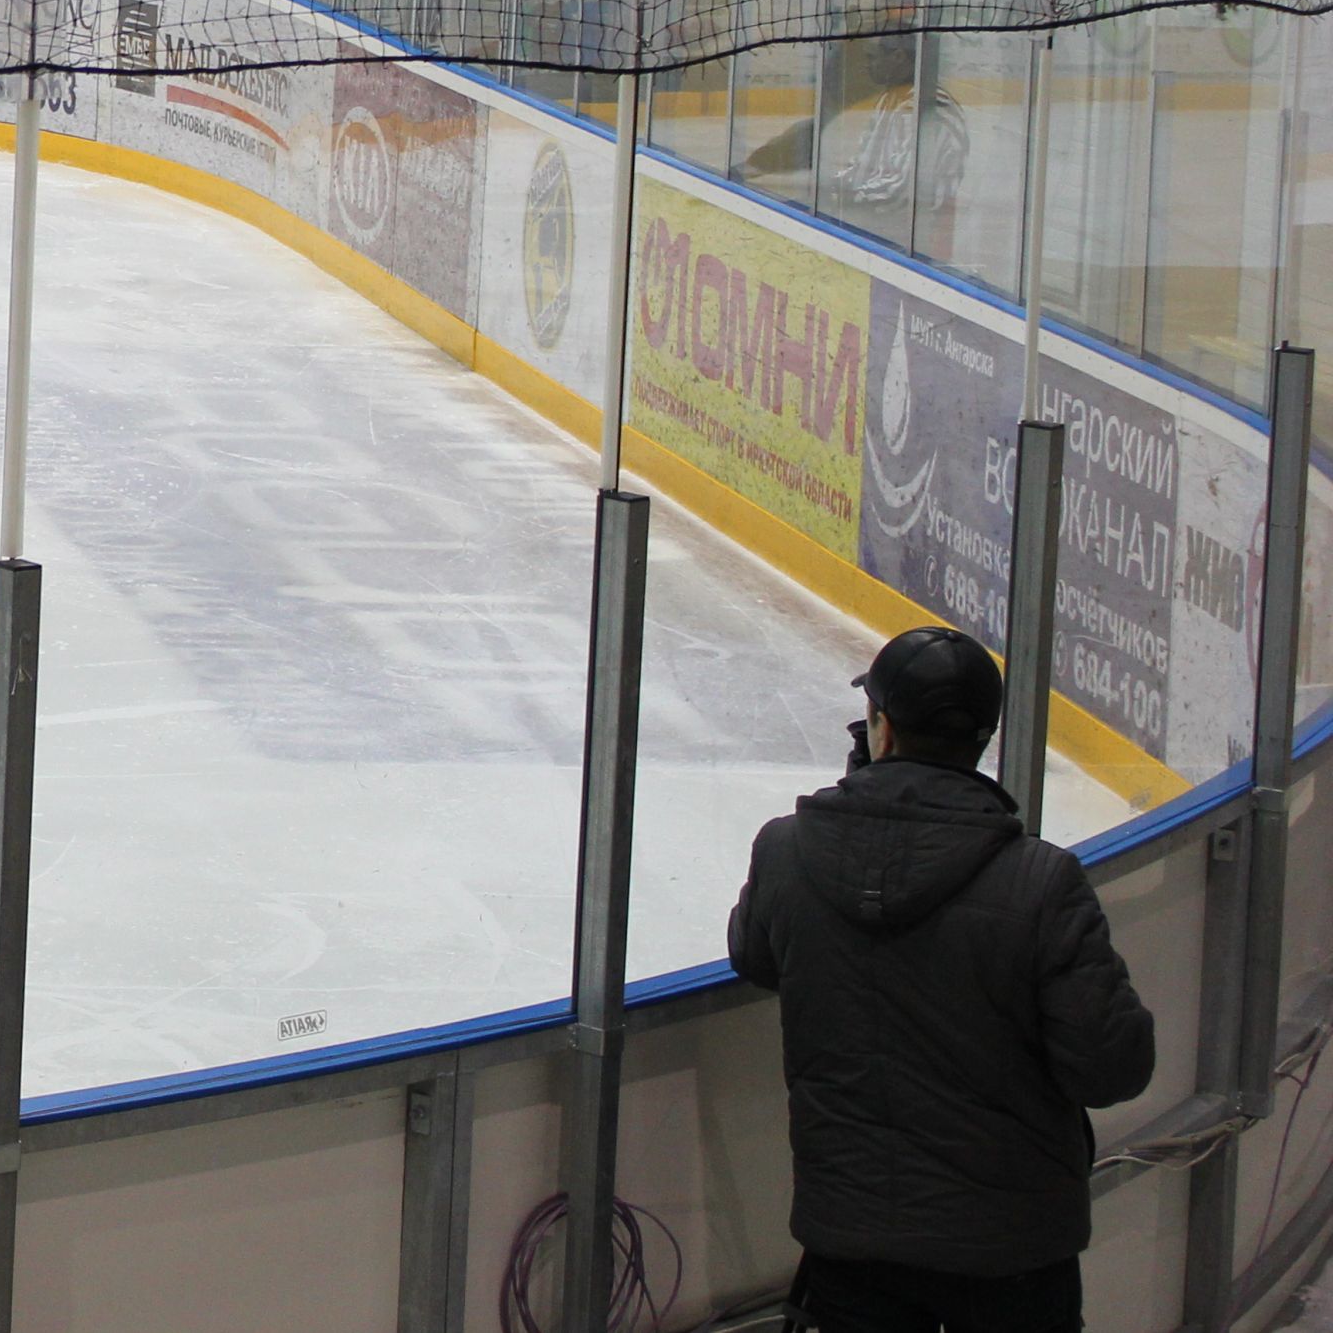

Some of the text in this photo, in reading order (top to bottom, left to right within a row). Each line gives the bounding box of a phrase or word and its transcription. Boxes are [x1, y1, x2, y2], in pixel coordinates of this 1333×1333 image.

[944, 330, 995, 378] Ангарска
[985, 436, 1171, 598] ВОКАНАЛ
[944, 564, 1161, 737] 688-10 684-100
